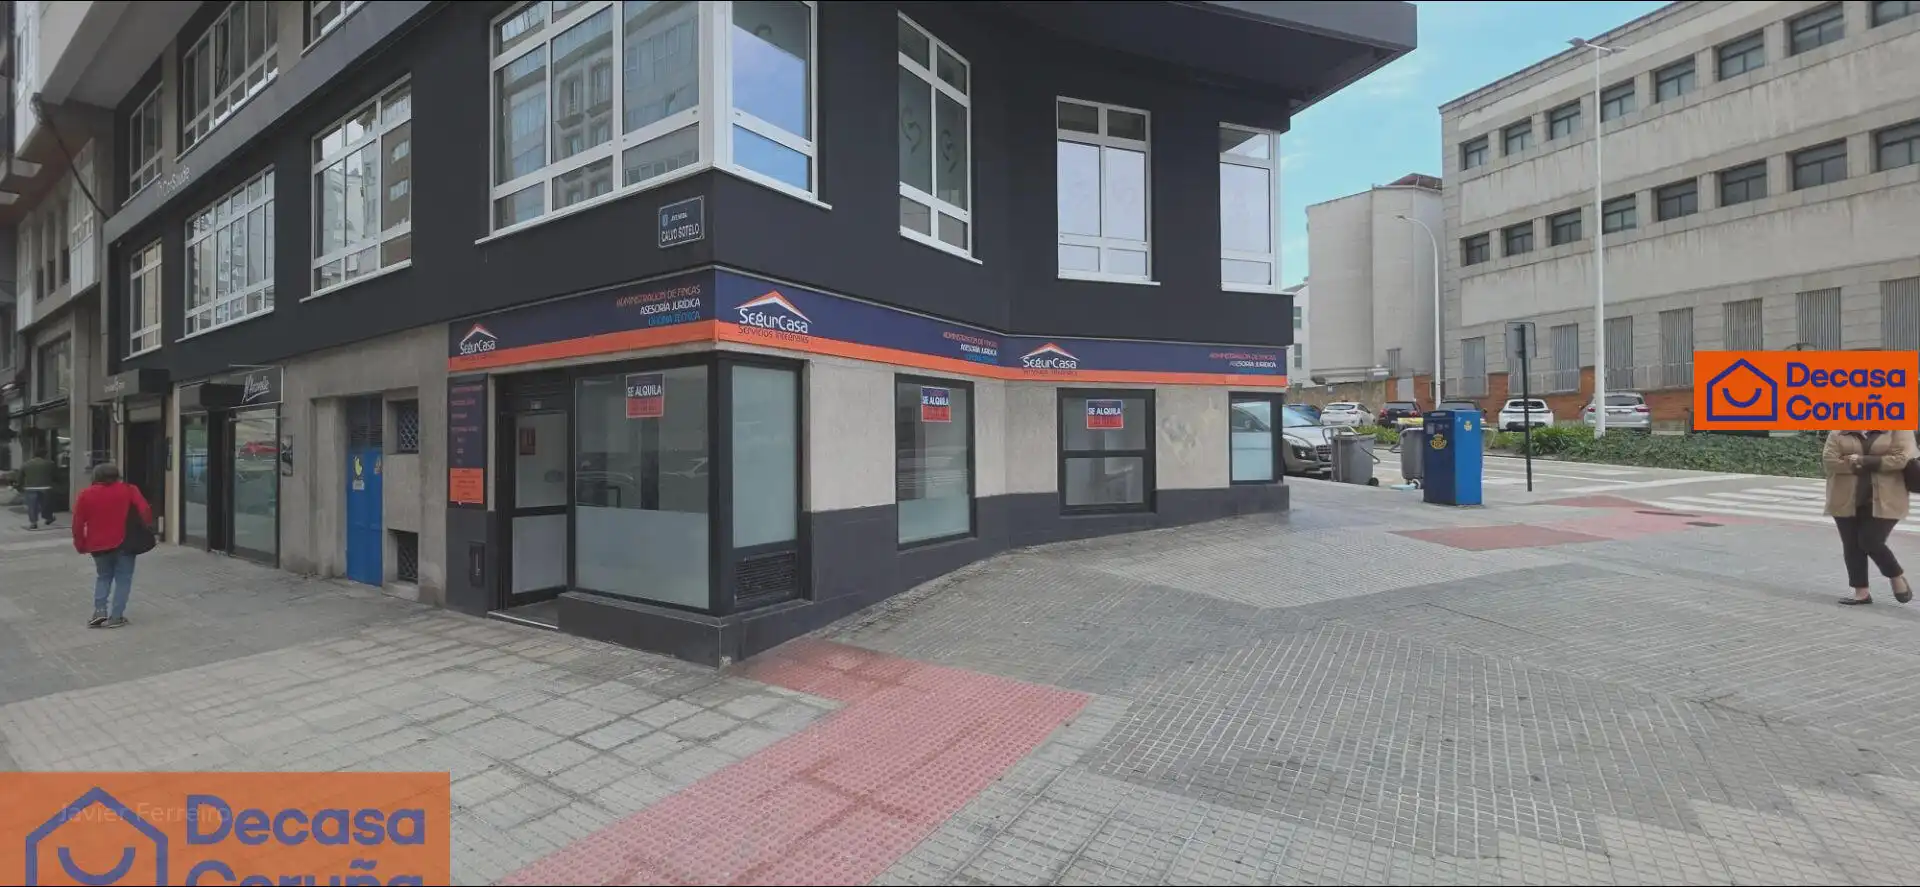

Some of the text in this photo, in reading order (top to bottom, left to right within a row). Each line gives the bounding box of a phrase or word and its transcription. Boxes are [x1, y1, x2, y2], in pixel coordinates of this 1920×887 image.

[661, 223, 700, 242] CALVO SOTELO
[627, 384, 662, 397] SE ALQUILA
[930, 396, 949, 406] ALQUILA
[1088, 407, 1121, 416] SE ALQUILA
